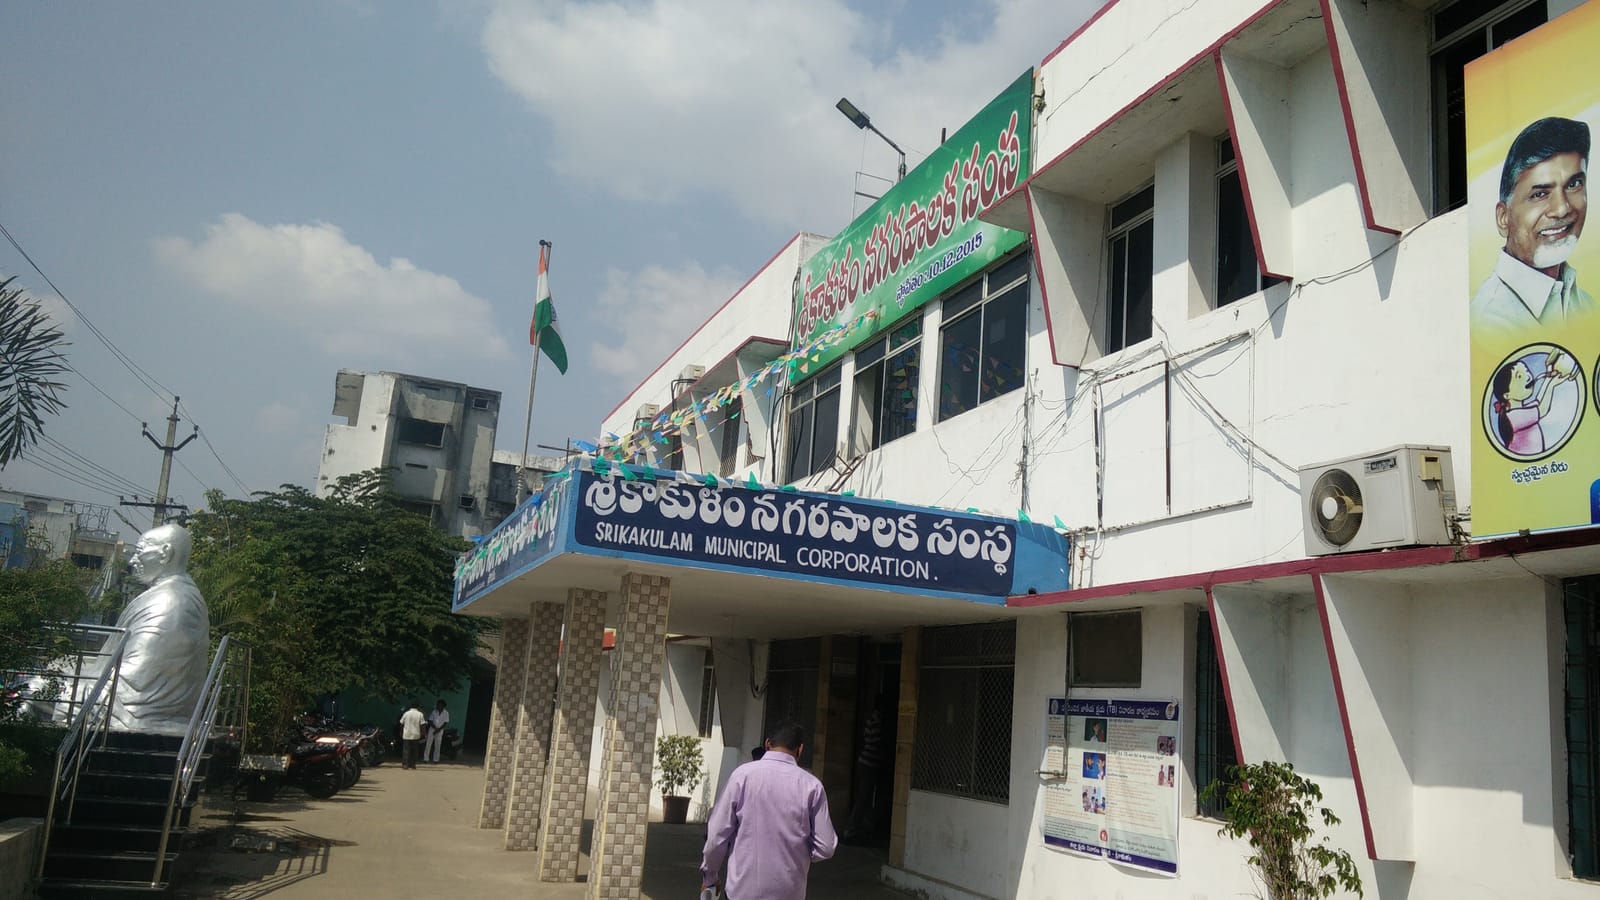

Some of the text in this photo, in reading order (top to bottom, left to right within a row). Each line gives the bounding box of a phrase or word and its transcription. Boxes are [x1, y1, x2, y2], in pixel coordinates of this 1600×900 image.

[862, 159, 959, 295] నగరపాలక
[1550, 461, 1569, 473] నీరు
[585, 474, 1012, 576] శ్రీకాకుళం నగరపాలక సంస్థ
[594, 521, 694, 552] SRIKAKULAM
[704, 535, 787, 564] MUNICIPAL
